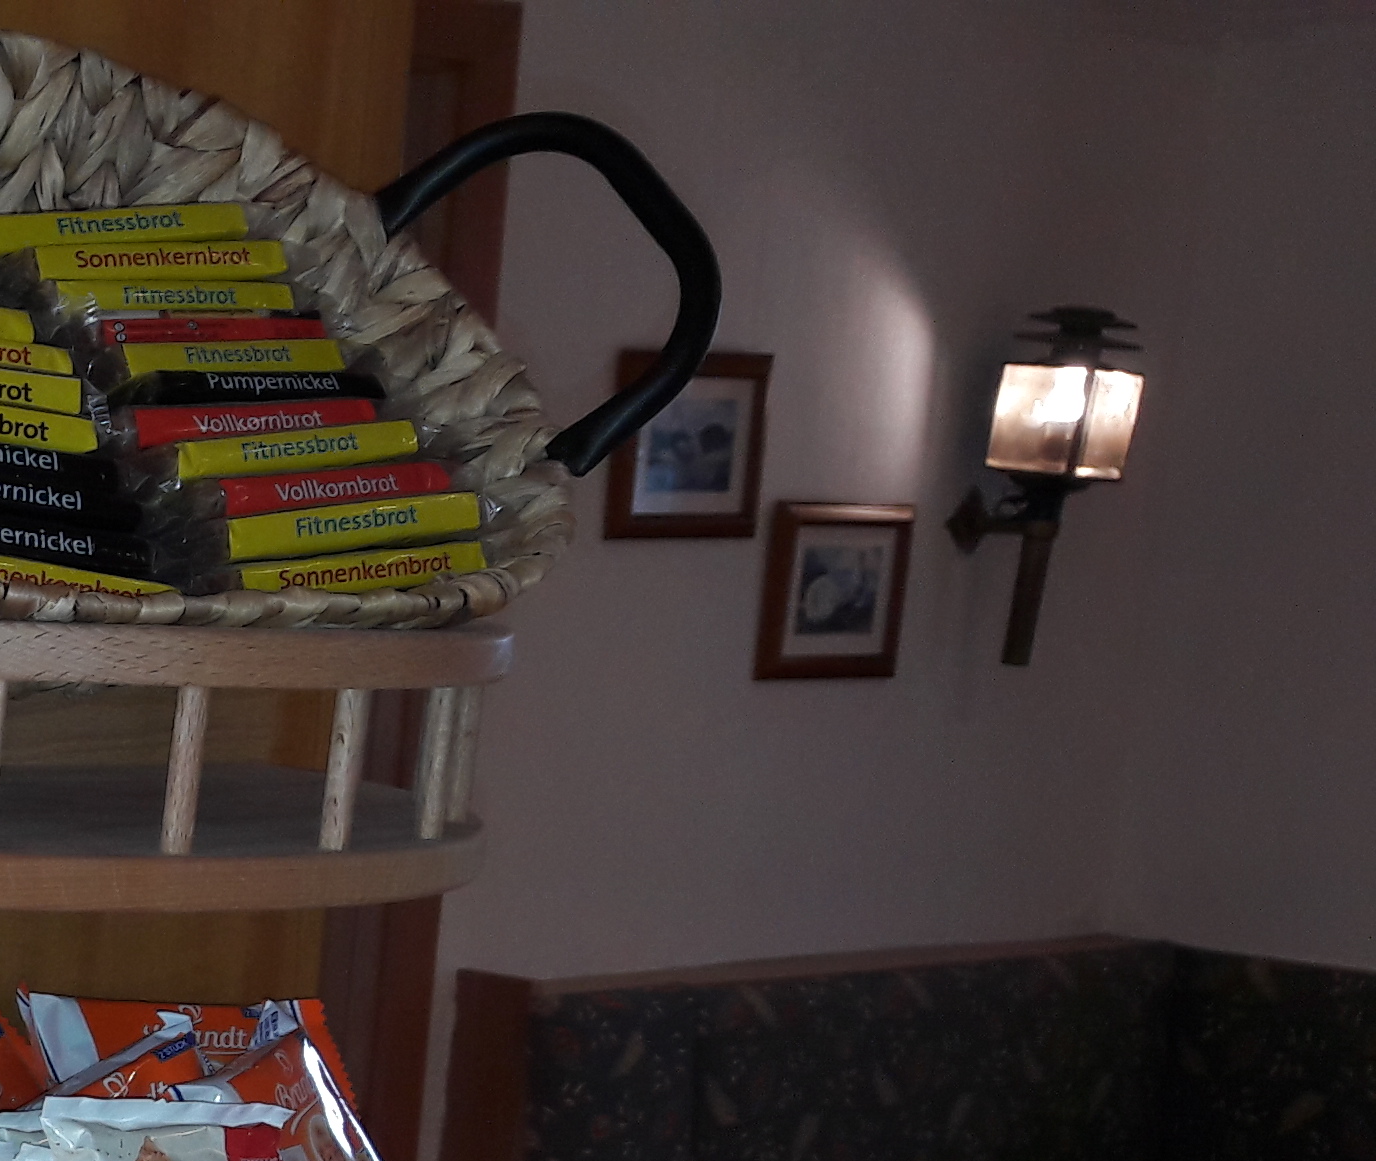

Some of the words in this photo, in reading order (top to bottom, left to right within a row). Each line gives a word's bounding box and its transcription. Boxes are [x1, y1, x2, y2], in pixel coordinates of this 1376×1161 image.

[56, 212, 185, 235] Fitnessbrot
[75, 246, 252, 269] Sonnenkernbrot
[122, 285, 238, 306] Fitnessbrot
[183, 345, 293, 365] Fitnessbrot
[206, 372, 340, 396] Pumpernickel
[193, 410, 324, 433] Vollkornbrot
[240, 432, 360, 462] Fitnessbrot
[274, 474, 399, 503] Vollkornbrot
[294, 507, 418, 538] Fitnessbrot
[278, 553, 452, 591] Sonnenkernbrot
